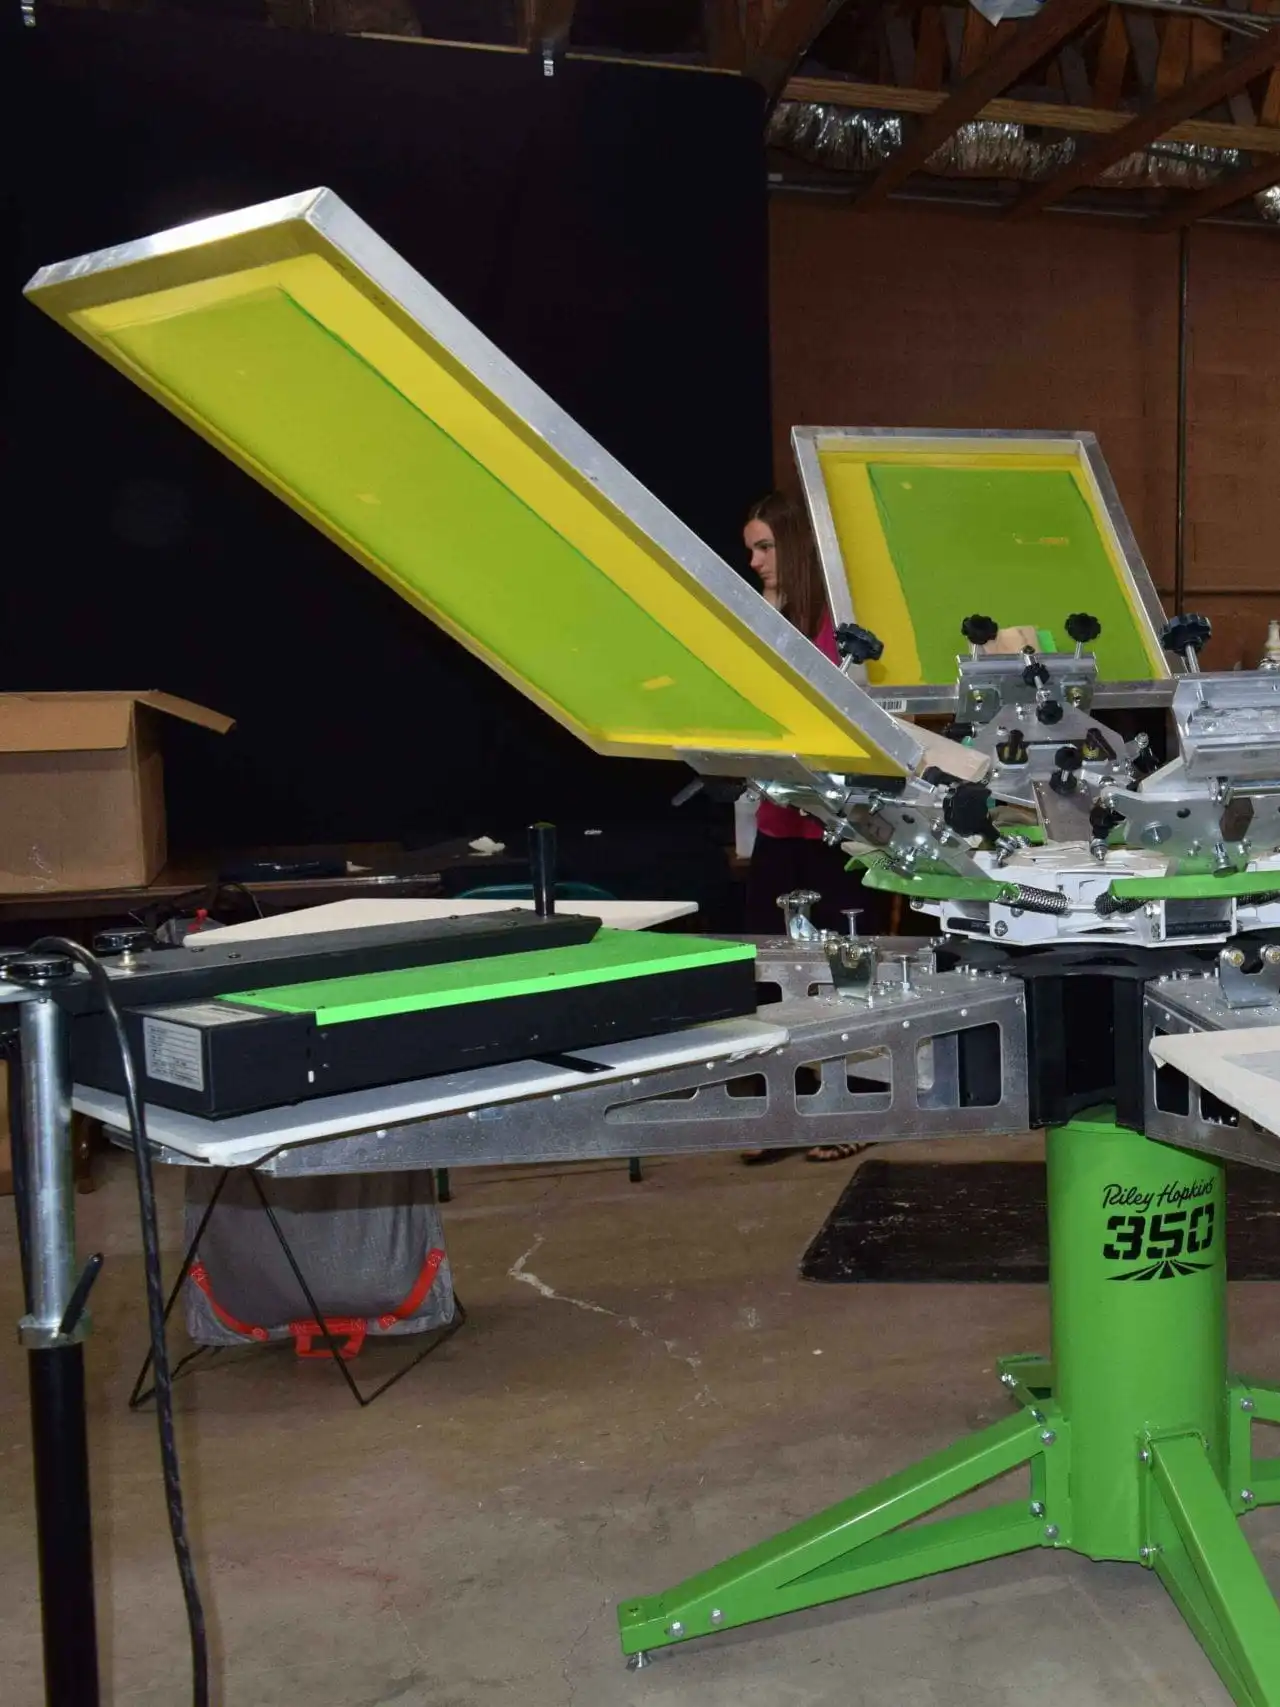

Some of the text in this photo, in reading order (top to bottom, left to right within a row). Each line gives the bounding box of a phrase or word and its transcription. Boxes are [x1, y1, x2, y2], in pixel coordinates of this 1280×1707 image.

[1102, 1177, 1215, 1213] Riley Hopkins
[1102, 1202, 1215, 1260] 350
